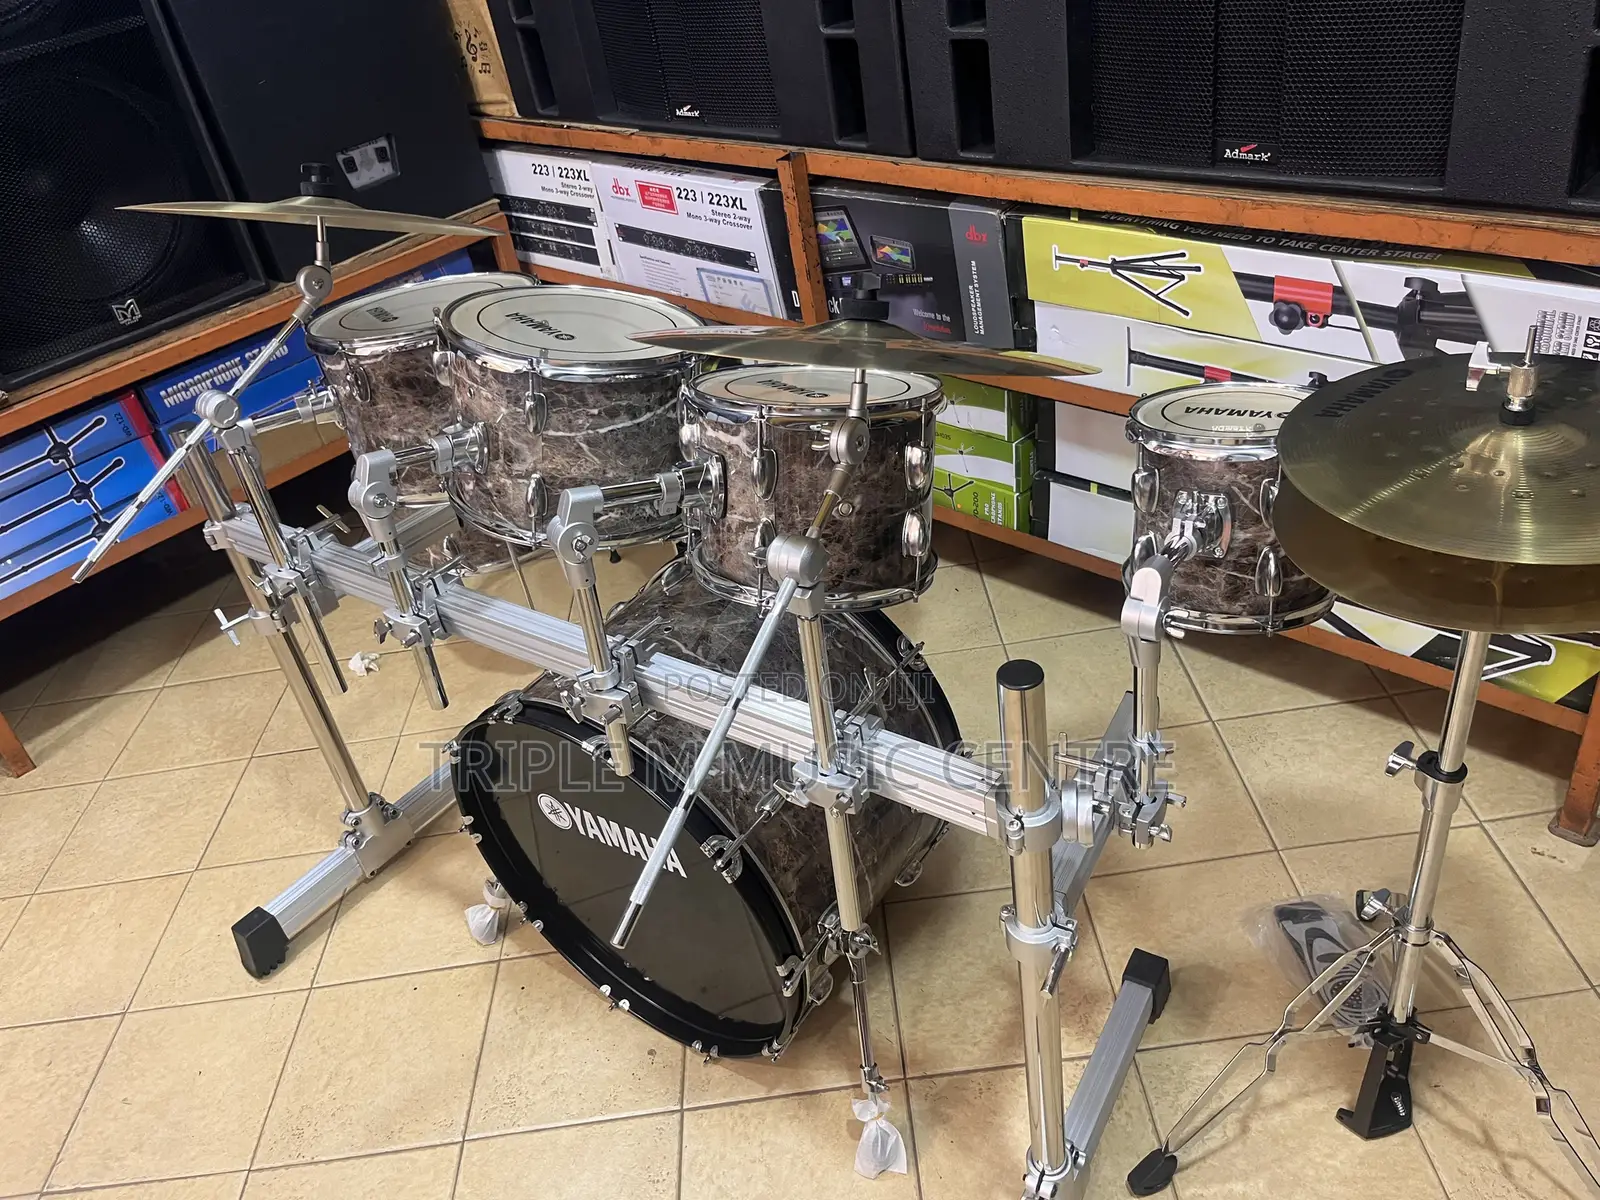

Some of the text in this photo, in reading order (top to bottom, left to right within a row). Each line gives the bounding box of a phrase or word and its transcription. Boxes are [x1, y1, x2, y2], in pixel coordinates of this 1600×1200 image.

[1223, 149, 1270, 161] Admark
[532, 163, 550, 176] 223
[558, 166, 590, 182] 223XL
[611, 177, 632, 197] dbx
[675, 186, 698, 203] 223
[707, 192, 748, 212] 223XL
[686, 211, 753, 230] Mono 3-way Crossover
[710, 209, 752, 224] Stereo 2-way
[965, 224, 989, 242] dbx
[1101, 213, 1443, 262] EVERYTHING YOU NEED TO TAKE CENTER STAGE!
[968, 285, 979, 334] LOUDSPEAKER
[970, 260, 985, 335] MANAGEMENT SYSTEM
[505, 312, 561, 336] YAMAHA
[159, 344, 289, 408] MICROPHONE STND
[1314, 378, 1398, 418] YAMAHA
[114, 412, 133, 437] WD-122
[1184, 406, 1278, 419] YAMAHA
[564, 802, 688, 879] YAMAHA
